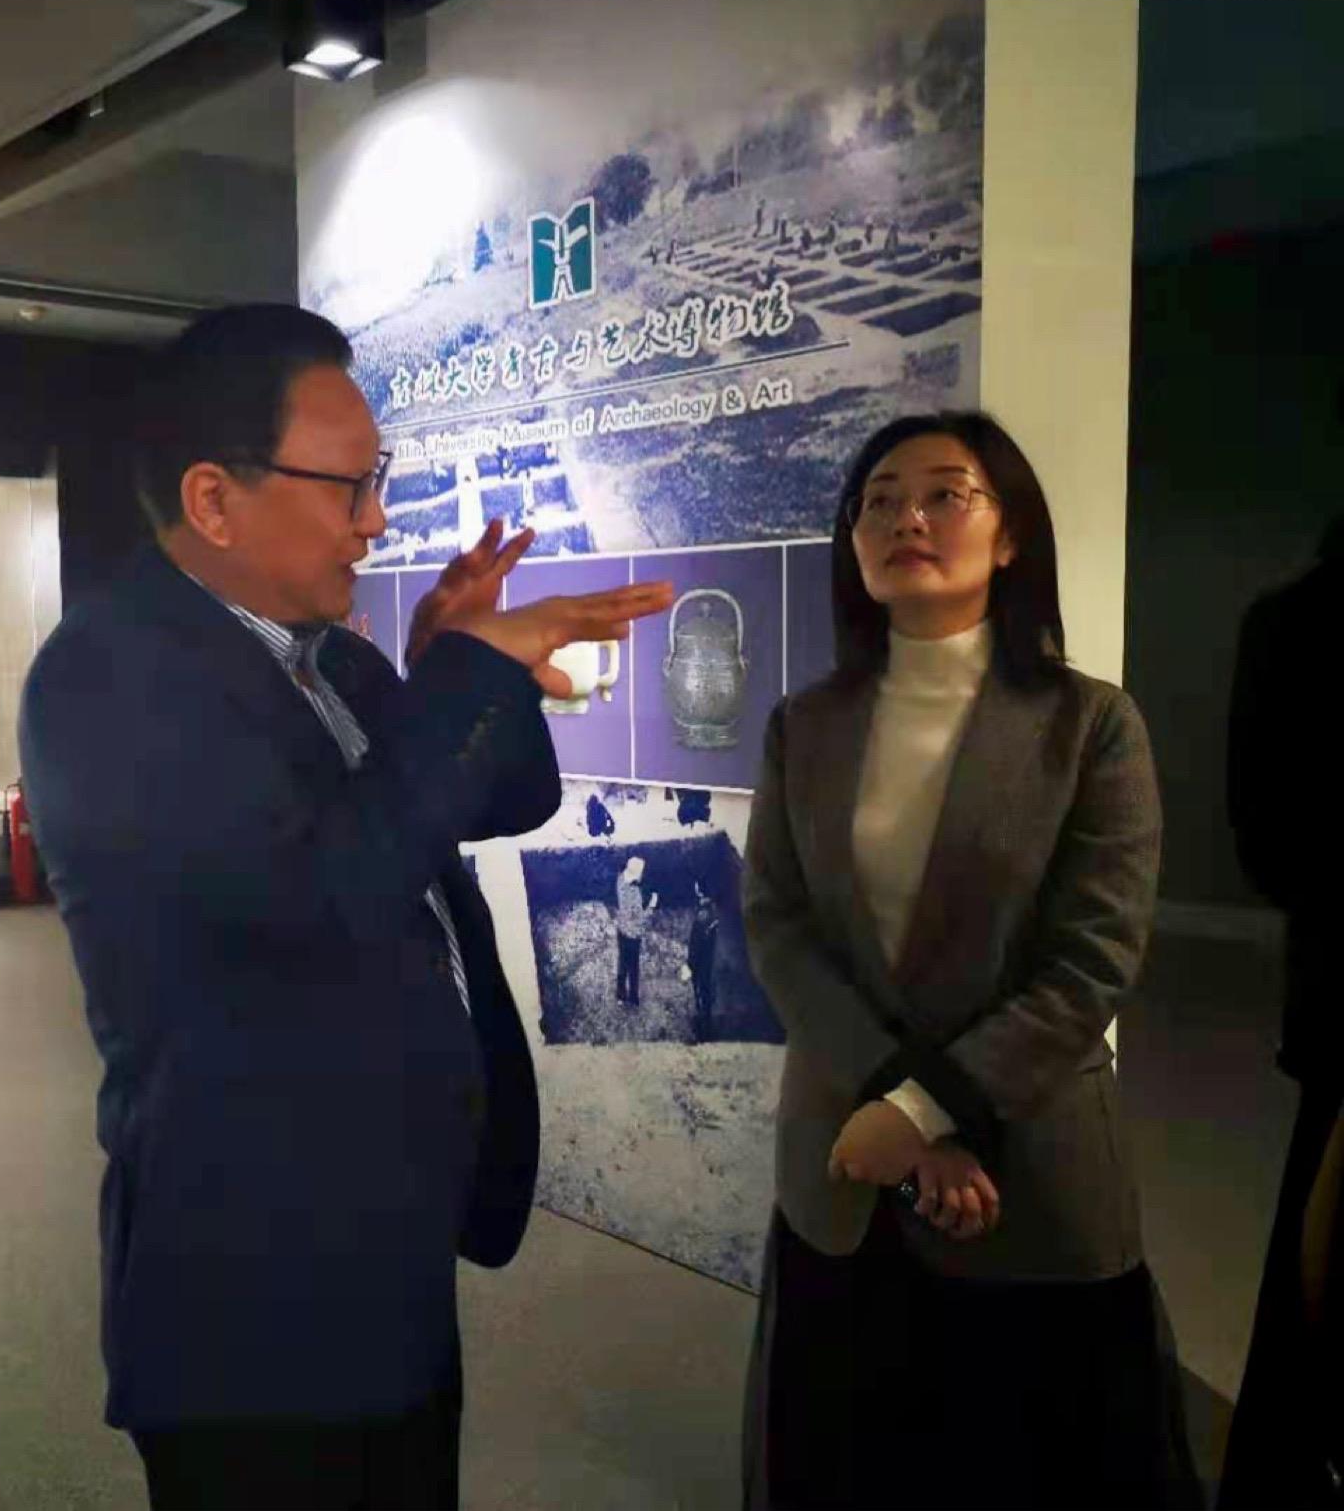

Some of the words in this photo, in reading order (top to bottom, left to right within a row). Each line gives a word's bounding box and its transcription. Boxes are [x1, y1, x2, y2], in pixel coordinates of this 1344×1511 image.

[503, 419, 565, 443] Museum
[575, 415, 593, 433] of
[603, 394, 712, 429] Archaeology
[725, 390, 742, 409] &
[757, 381, 790, 404] Art
